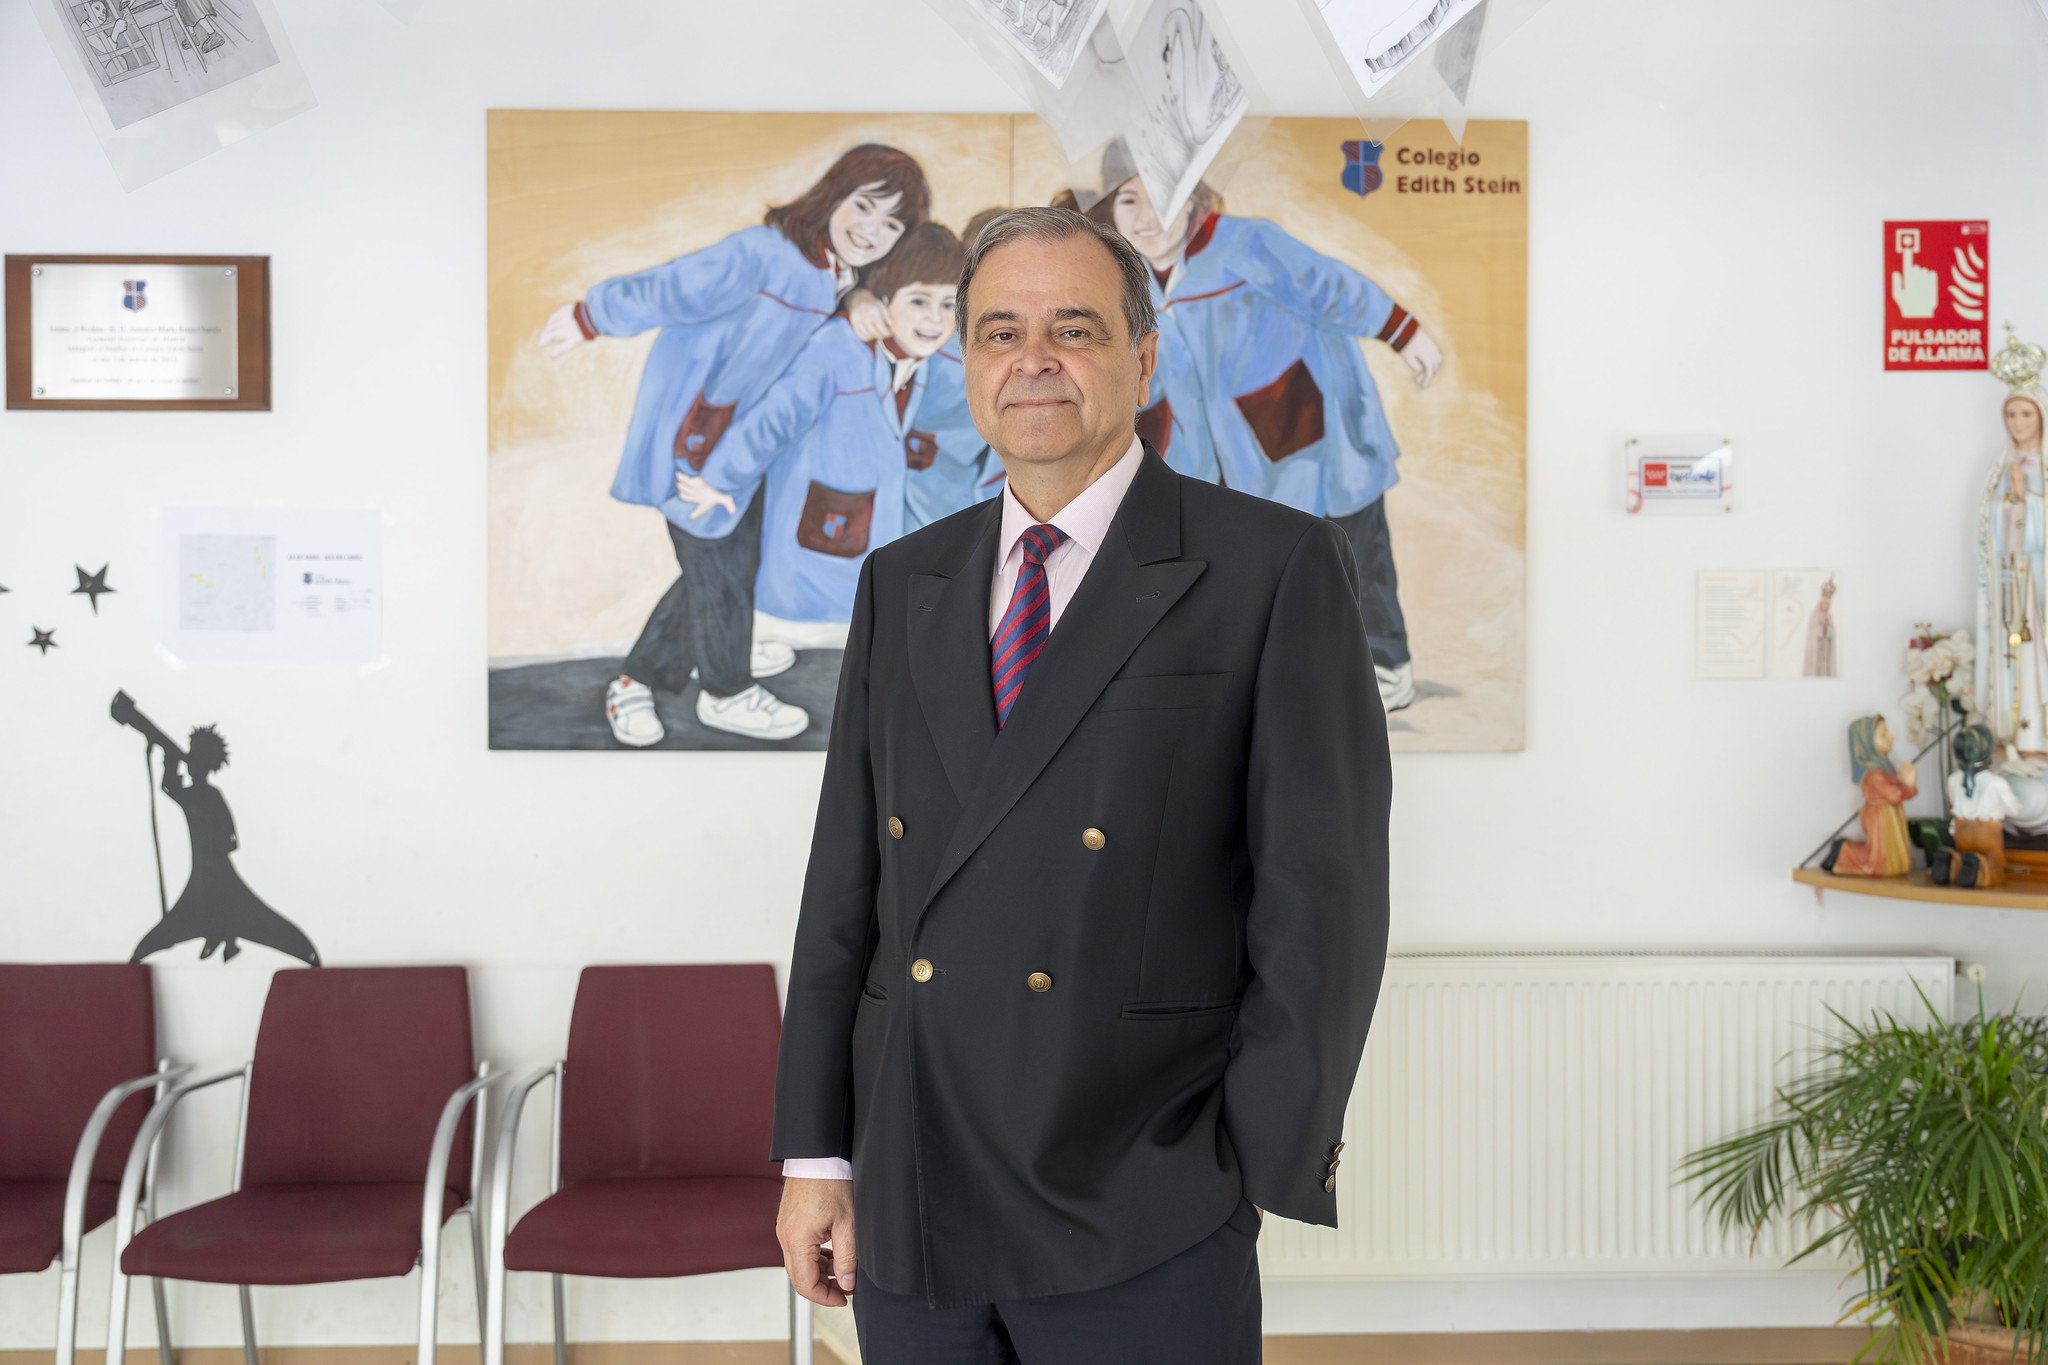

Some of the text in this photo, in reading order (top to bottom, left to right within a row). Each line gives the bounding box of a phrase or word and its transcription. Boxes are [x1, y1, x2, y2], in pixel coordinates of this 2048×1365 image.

[1396, 147, 1480, 171] Colegio
[1396, 176, 1521, 194] Edith Stein
[1891, 329, 1982, 345] PULSADOR
[1888, 347, 1985, 362] DE ALARMA
